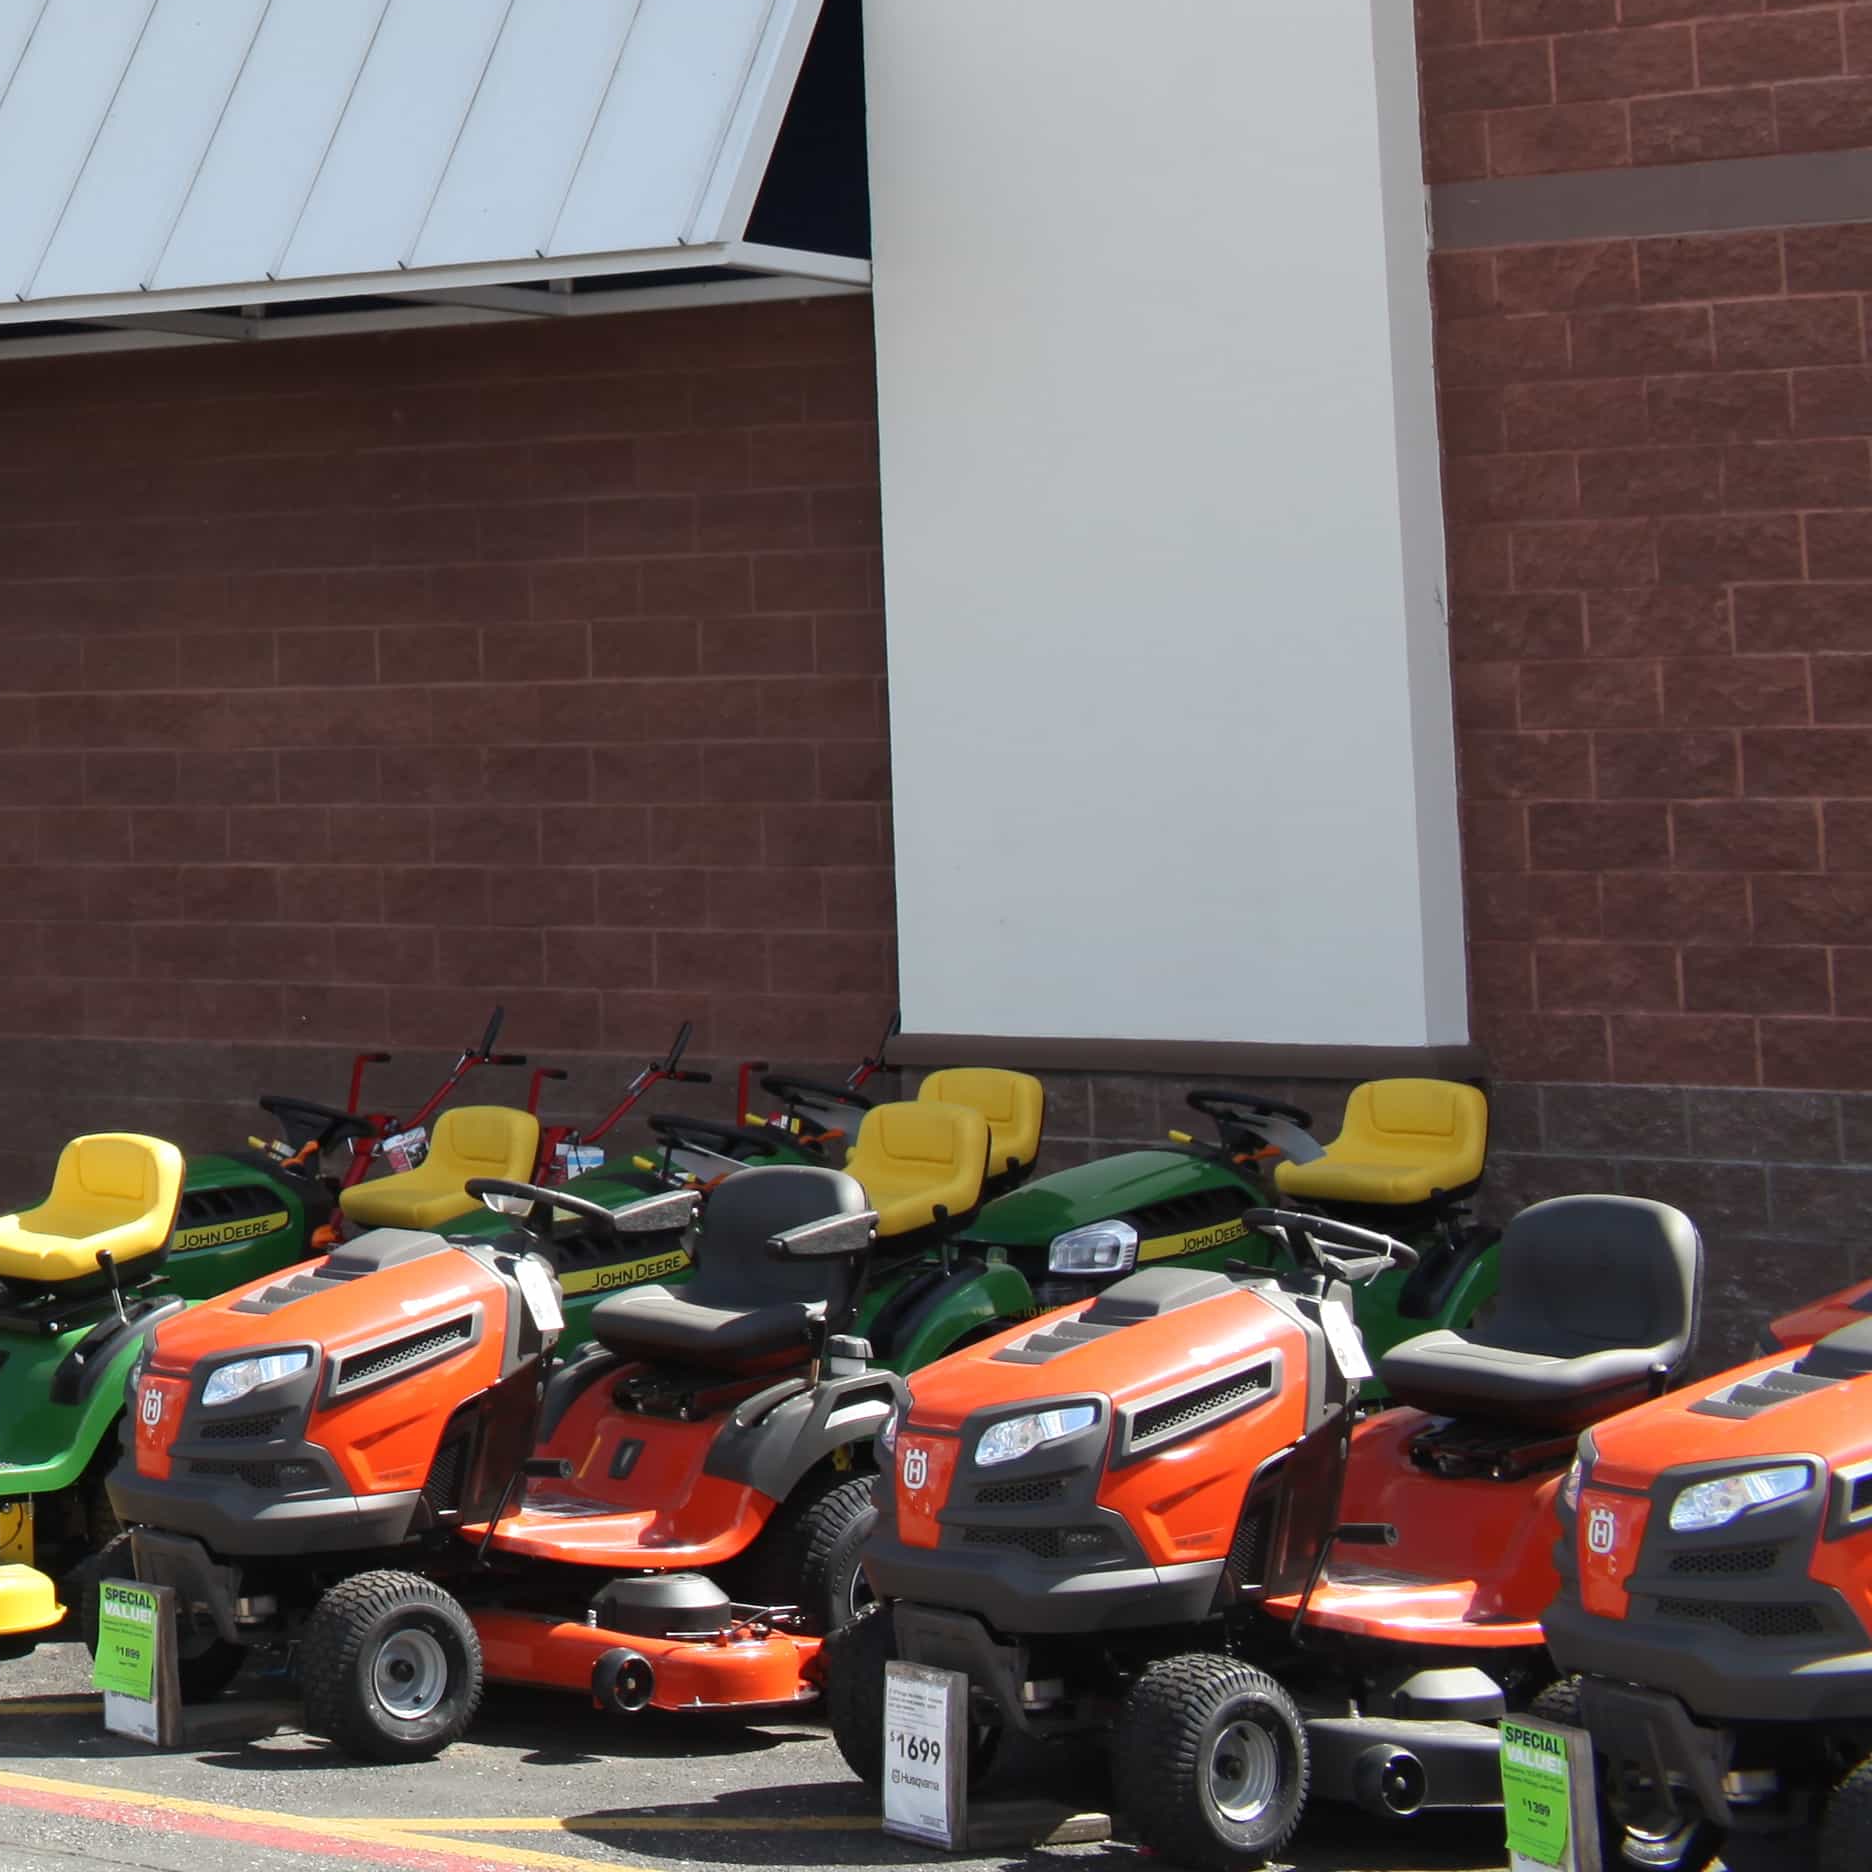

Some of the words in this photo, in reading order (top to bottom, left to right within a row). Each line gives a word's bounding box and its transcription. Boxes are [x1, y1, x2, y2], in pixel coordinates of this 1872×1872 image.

[179, 1231, 221, 1249] JOHN
[223, 1219, 270, 1240] DEERE
[1181, 1233, 1213, 1252] JOHN
[592, 1269, 633, 1289] JOHN
[636, 1256, 681, 1279] DEERE
[105, 1586, 152, 1609] SPECIAL
[890, 1731, 941, 1765] $1699
[1505, 1726, 1561, 1755] SPECIAL
